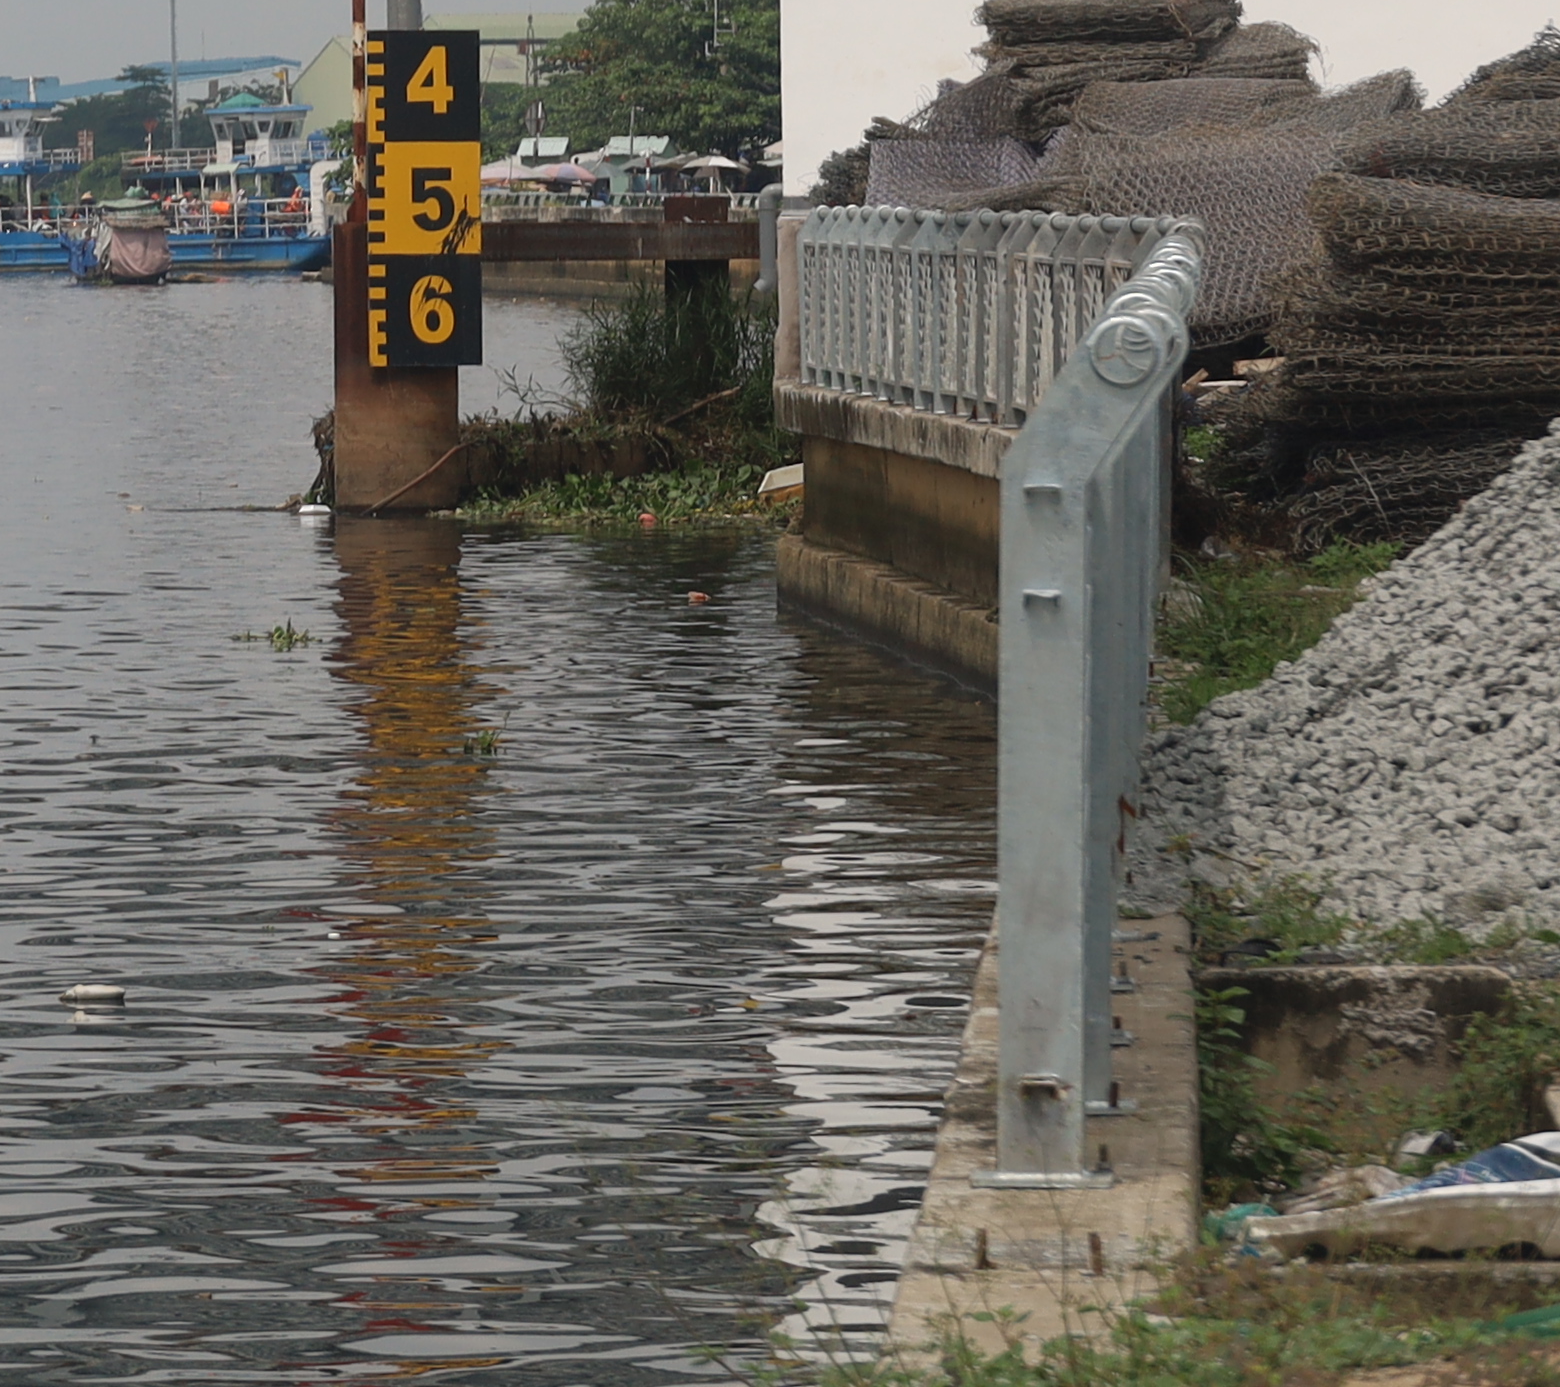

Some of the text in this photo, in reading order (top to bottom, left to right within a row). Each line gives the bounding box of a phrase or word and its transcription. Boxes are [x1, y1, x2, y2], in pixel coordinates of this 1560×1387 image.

[406, 45, 454, 114] 4
[411, 167, 455, 231] 5
[409, 274, 454, 344] 6
